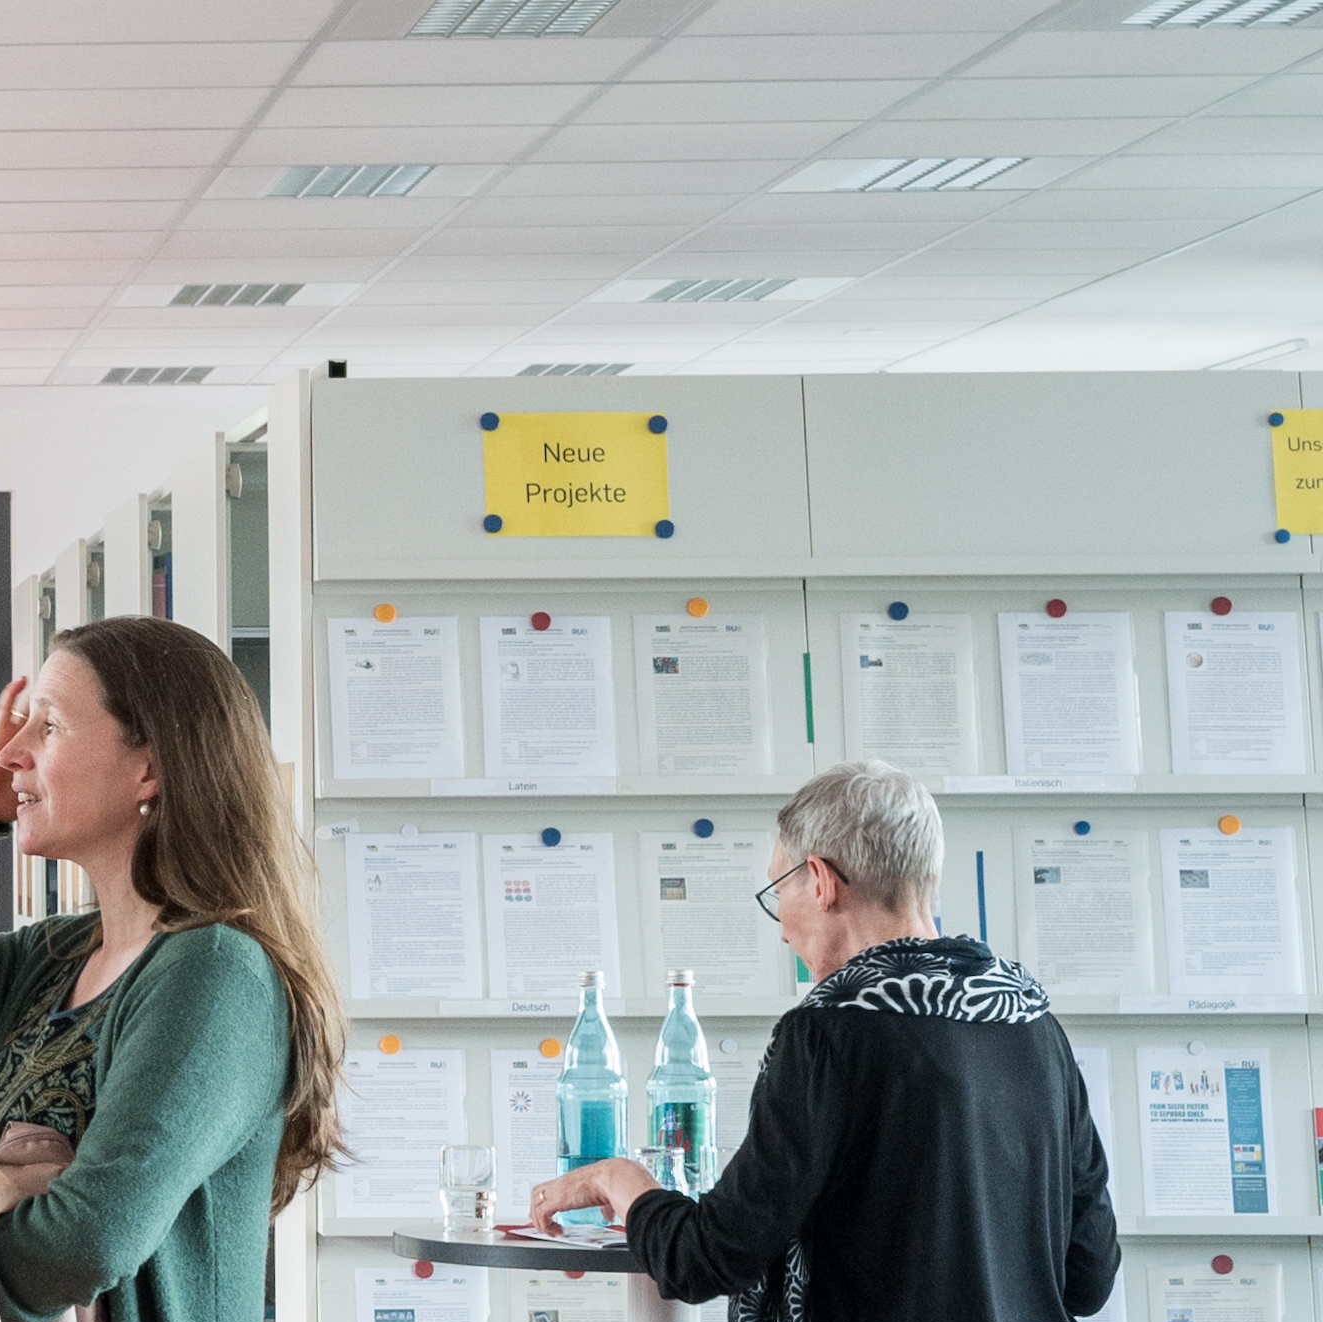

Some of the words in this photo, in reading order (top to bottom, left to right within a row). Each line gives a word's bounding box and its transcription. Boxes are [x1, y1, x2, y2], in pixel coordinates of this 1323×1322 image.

[543, 442, 606, 463] Neue
[525, 482, 626, 508] Projekte
[508, 781, 538, 791] Latein
[1014, 777, 1062, 788] Italienisch
[331, 826, 350, 836] Neu
[511, 1001, 551, 1012] Deutsch
[1188, 999, 1237, 1011] Pädagogik
